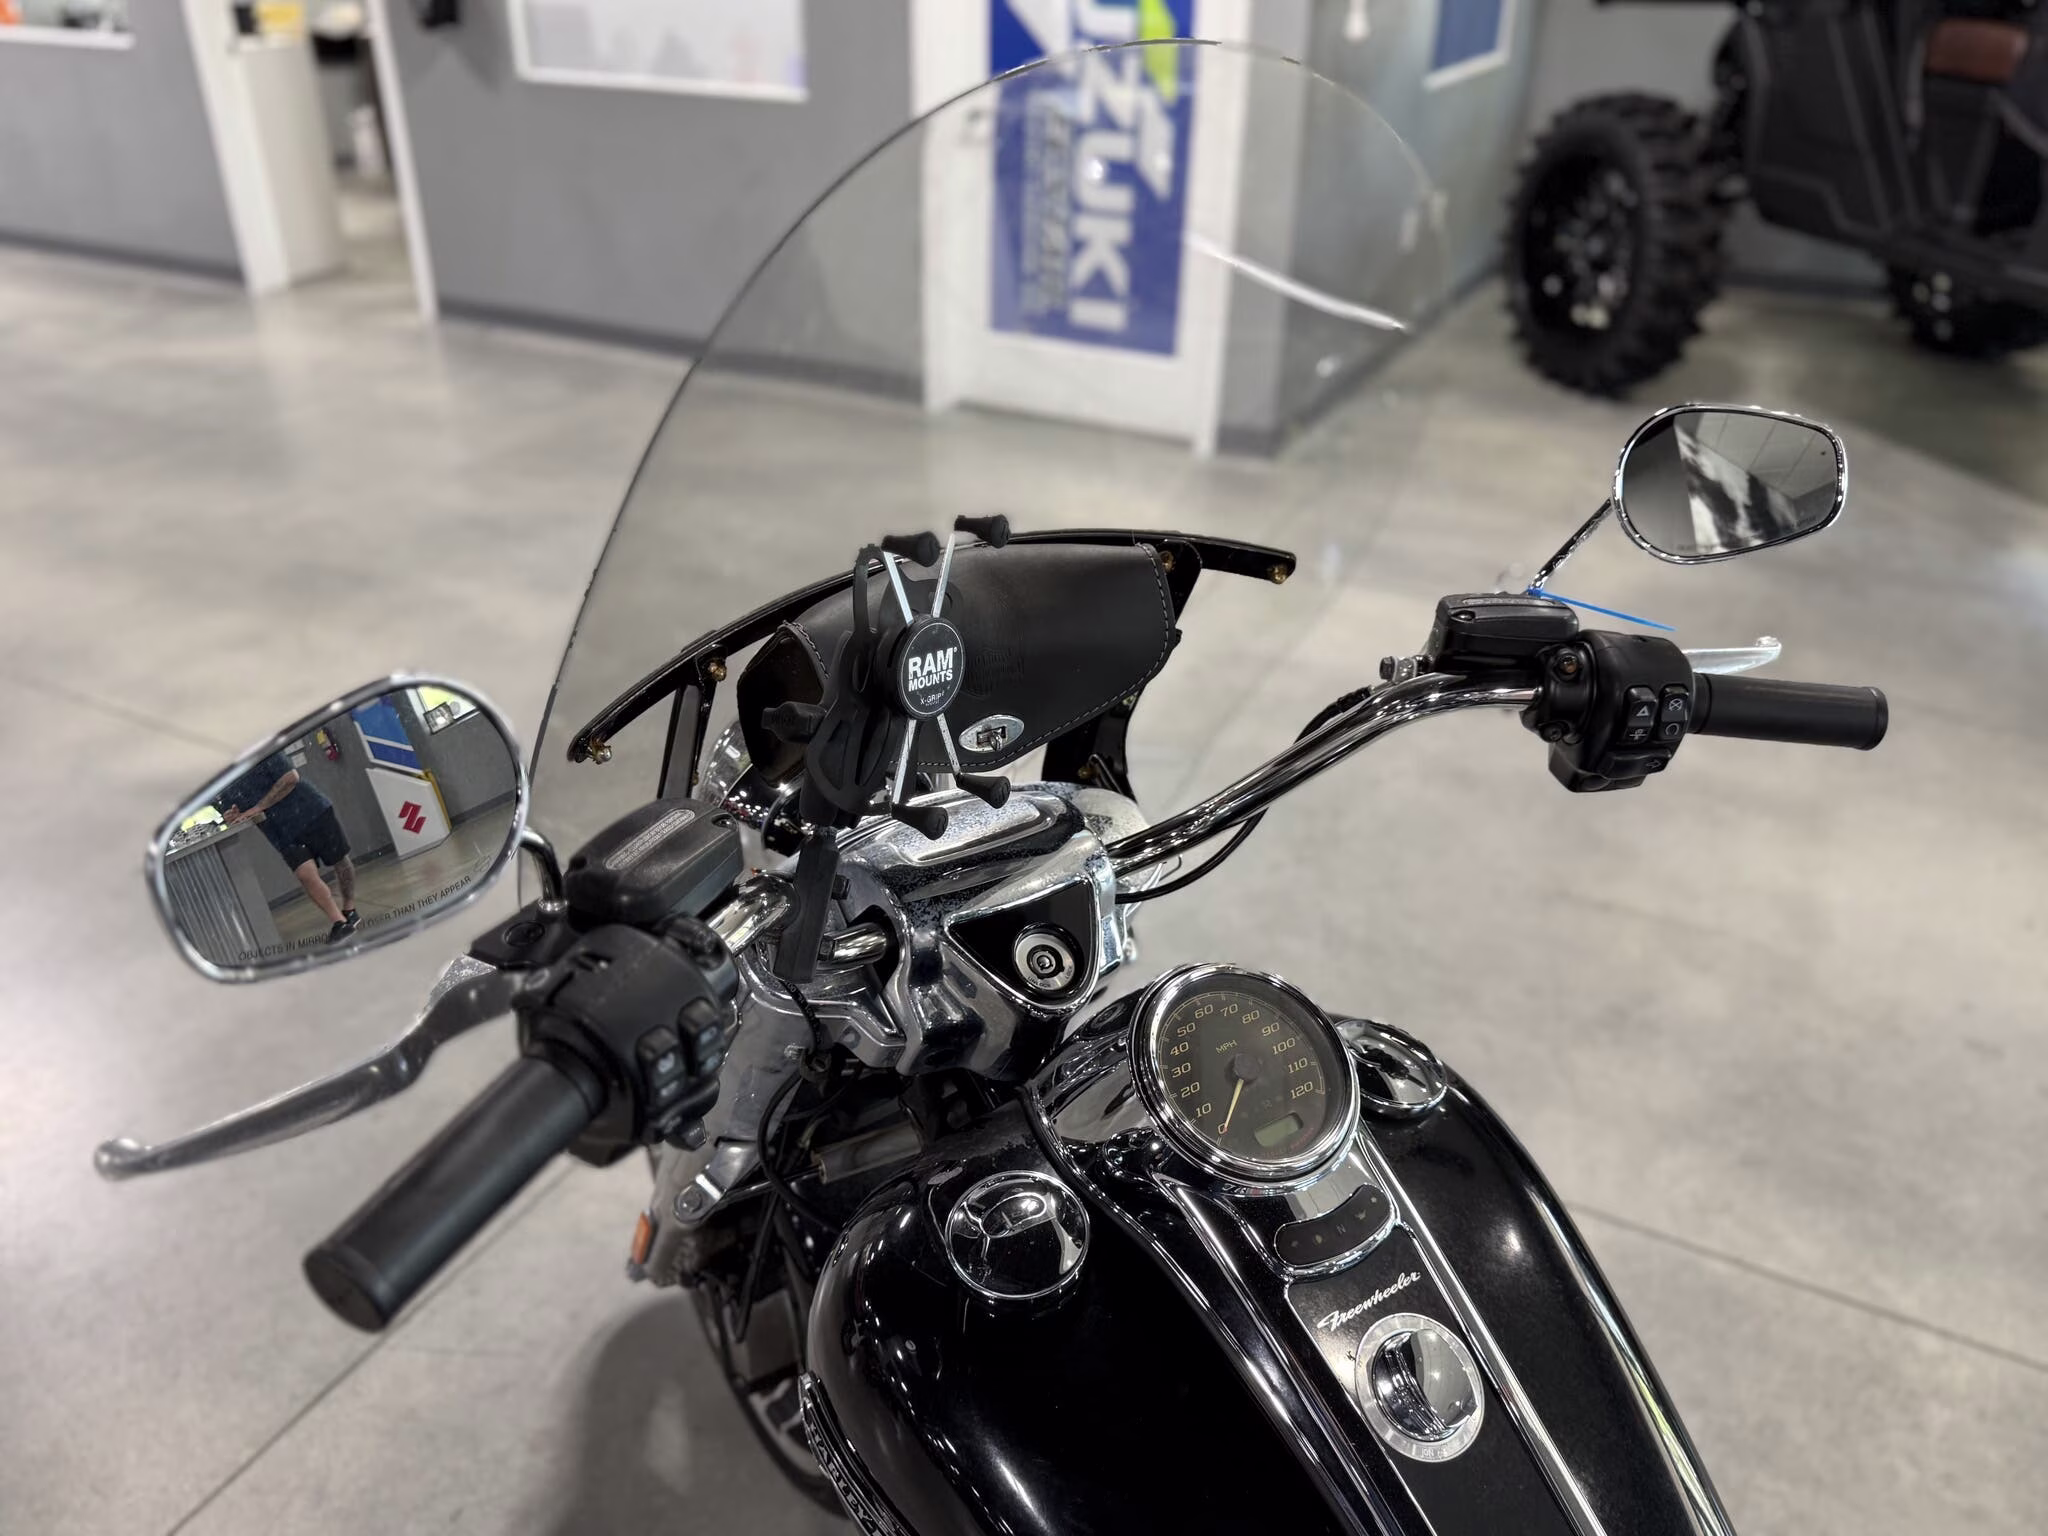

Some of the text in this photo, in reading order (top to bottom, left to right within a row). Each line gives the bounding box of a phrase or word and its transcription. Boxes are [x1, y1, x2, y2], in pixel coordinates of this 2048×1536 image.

[908, 668, 953, 692] MOUNTS
[286, 941, 295, 952] IN
[298, 933, 331, 949] MIRRO
[356, 912, 391, 930] CLOR
[393, 904, 415, 918] THAN
[417, 893, 438, 909] THEY
[440, 875, 471, 898] APPEAR
[1194, 1004, 1214, 1020] 60
[1220, 1003, 1239, 1017] 70
[1242, 1010, 1260, 1025] 80
[1176, 1022, 1196, 1038] 50
[1261, 1022, 1280, 1037] 90
[1169, 1041, 1189, 1057] 40
[1216, 1040, 1237, 1054] MPH
[1272, 1037, 1296, 1055] 100
[1171, 1062, 1192, 1079] 30
[1288, 1057, 1308, 1074] 110
[1180, 1081, 1200, 1098] 20
[1290, 1081, 1313, 1099] 120
[1195, 1102, 1212, 1118] 10
[1317, 1271, 1421, 1331] Freewheeler
